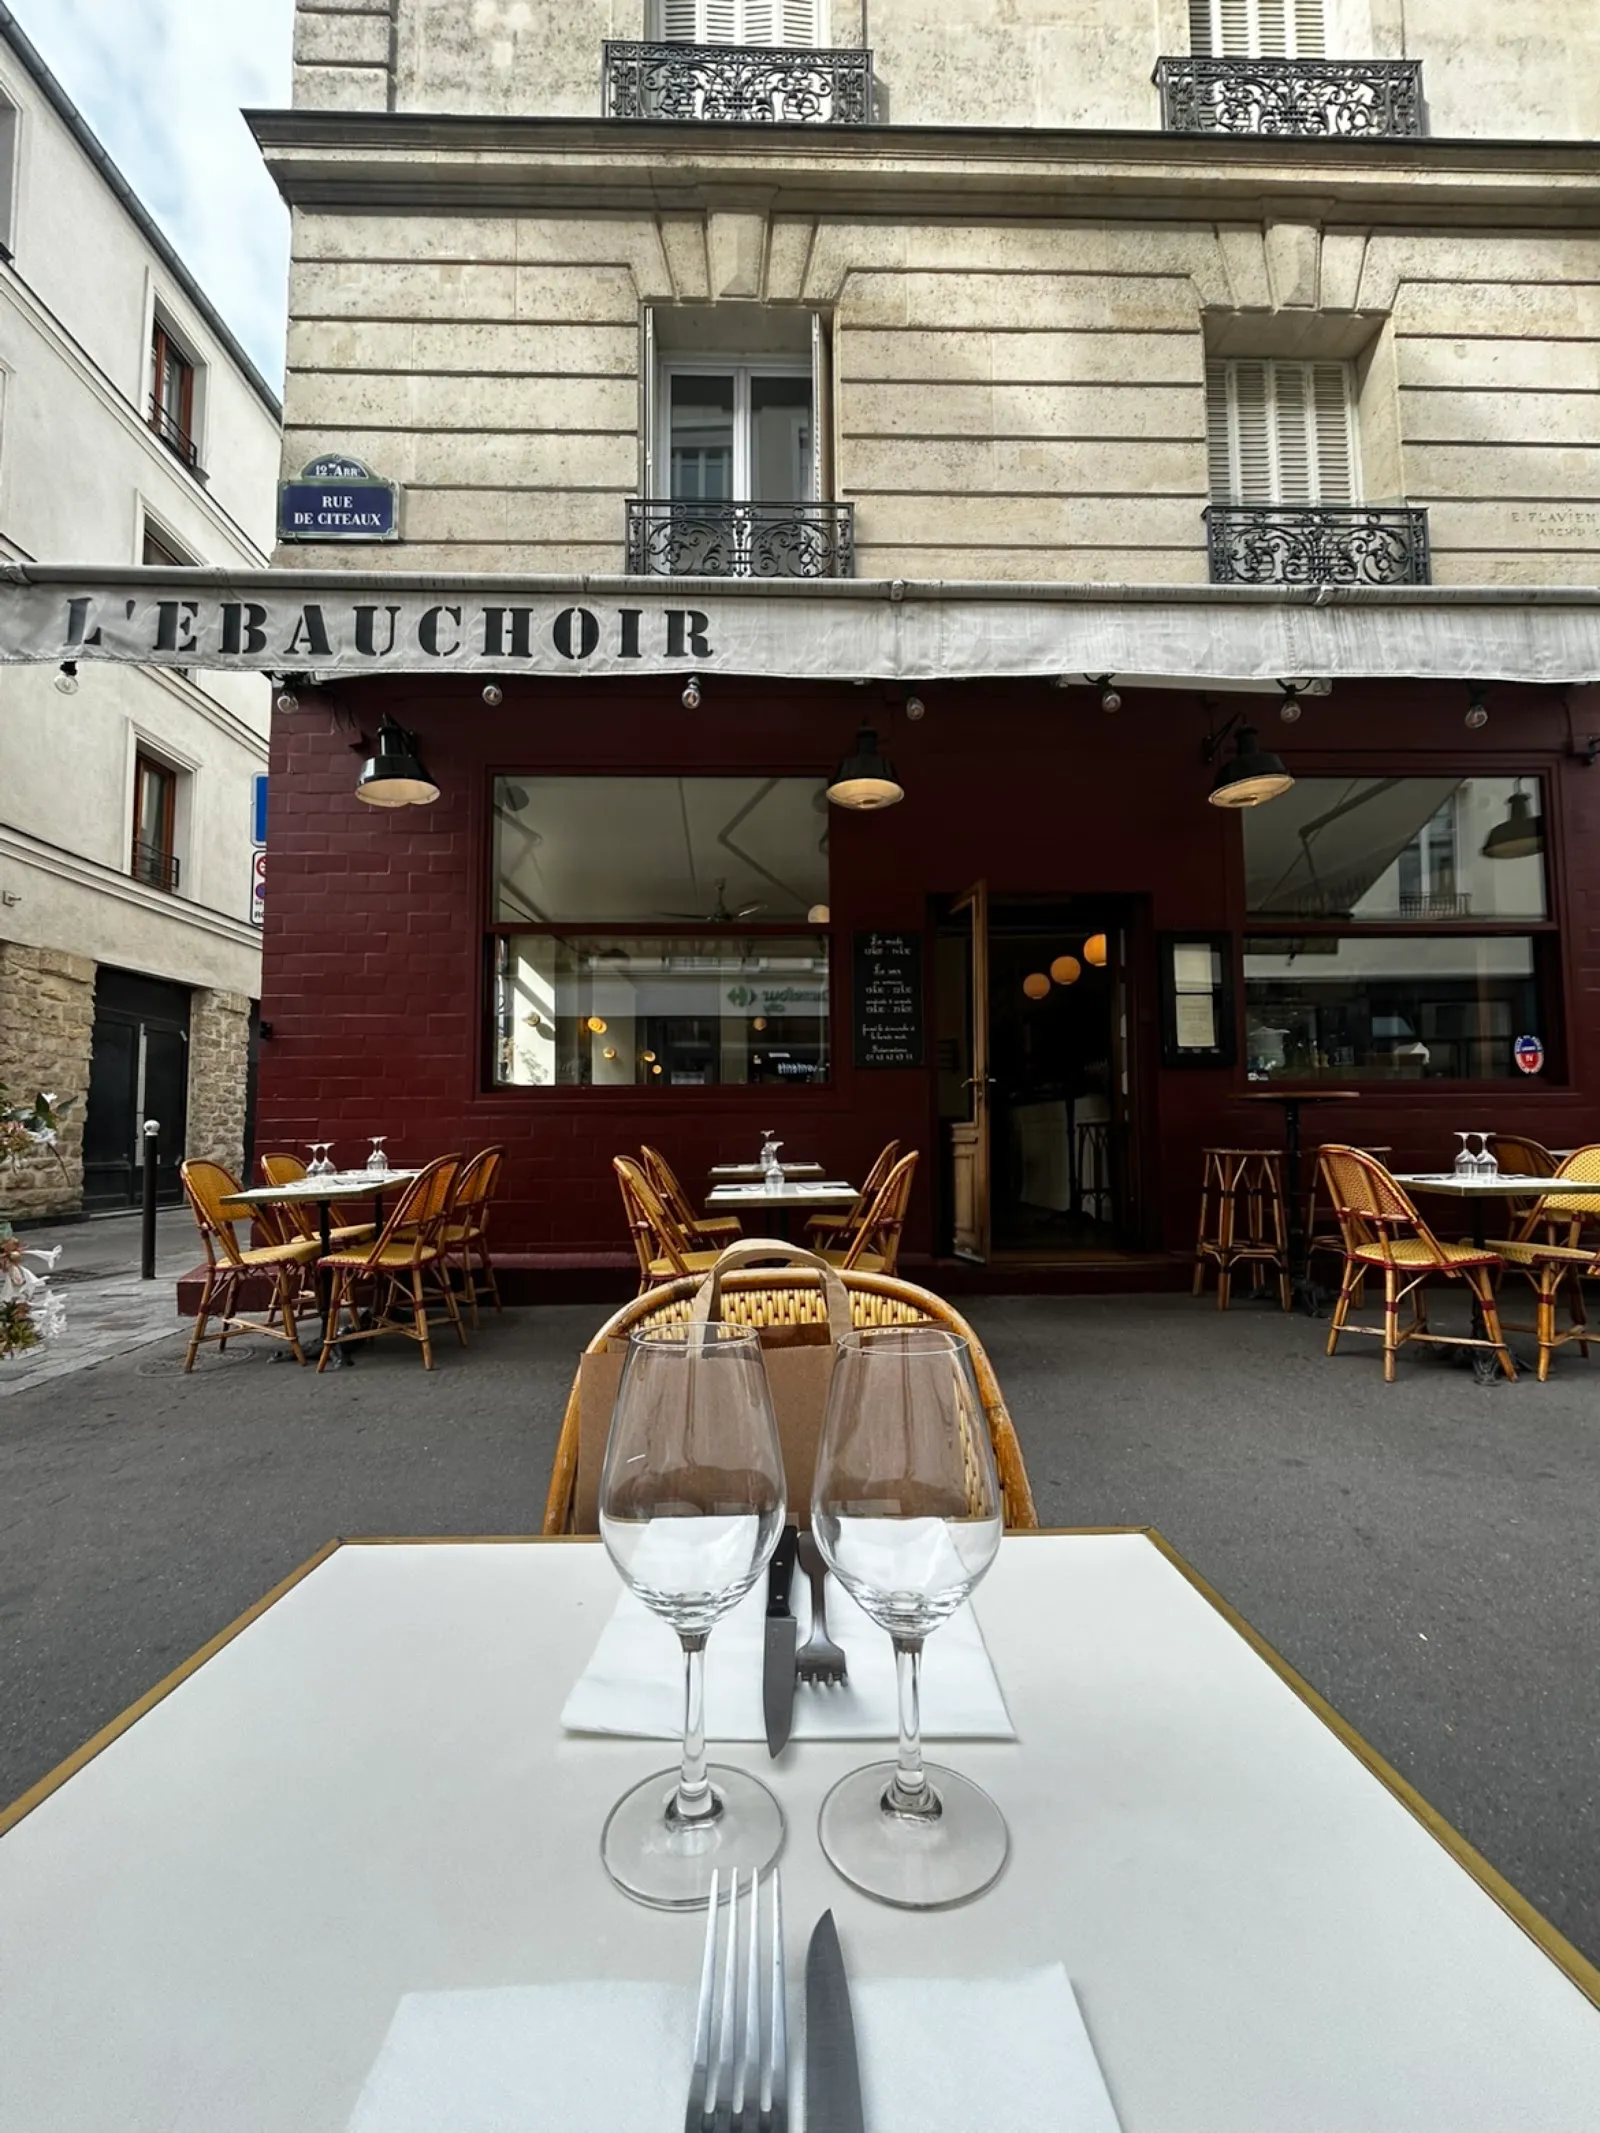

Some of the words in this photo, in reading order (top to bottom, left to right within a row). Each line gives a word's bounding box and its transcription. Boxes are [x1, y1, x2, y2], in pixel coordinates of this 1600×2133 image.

[322, 495, 353, 508] RUE
[294, 512, 314, 525] DE
[317, 512, 381, 526] CITEAUX
[63, 595, 715, 661] L'EBAUCHOIR
